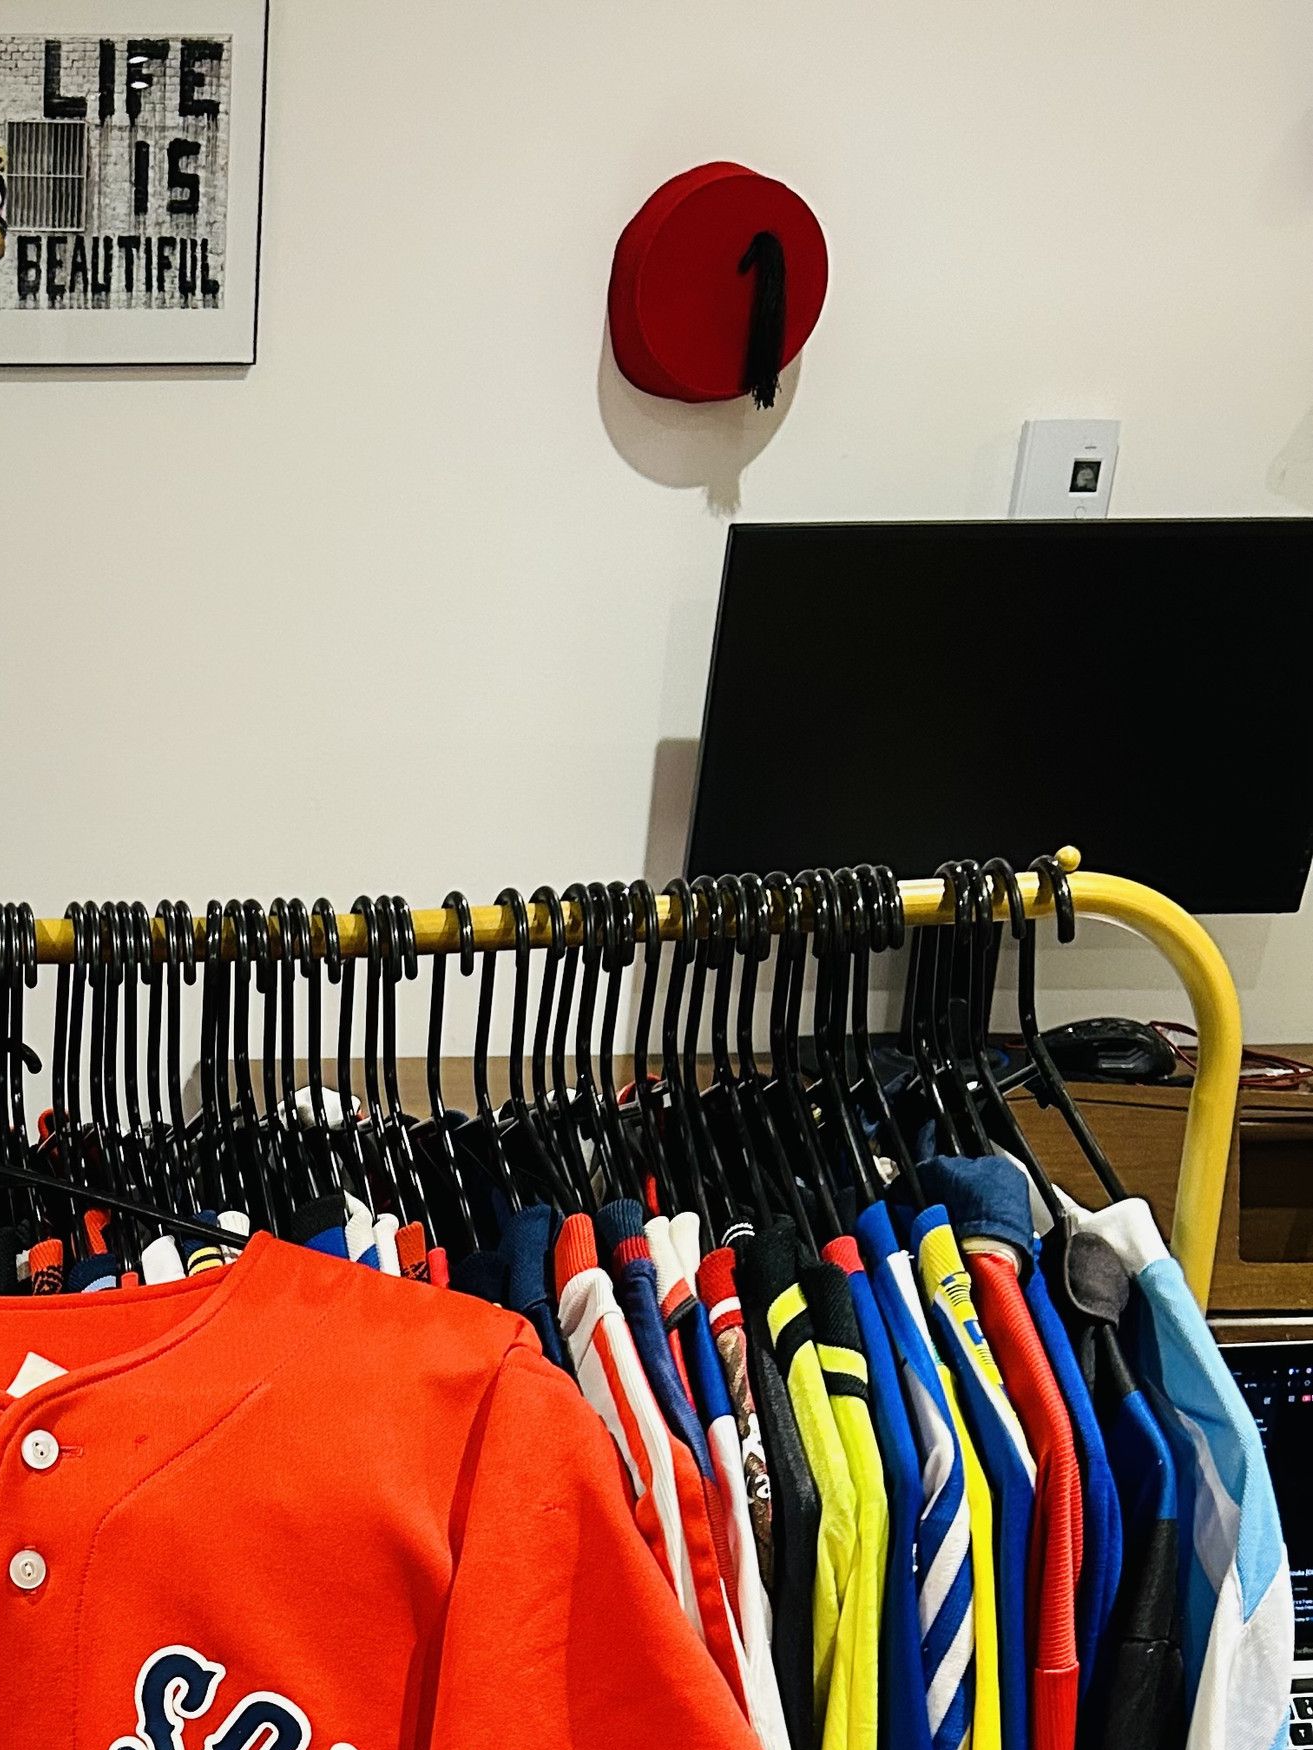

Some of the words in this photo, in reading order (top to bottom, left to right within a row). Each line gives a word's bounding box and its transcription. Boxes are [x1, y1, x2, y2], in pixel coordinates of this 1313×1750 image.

[43, 38, 224, 120] LIFE
[134, 138, 202, 215] IS
[16, 235, 220, 297] BEAUTIFUL
